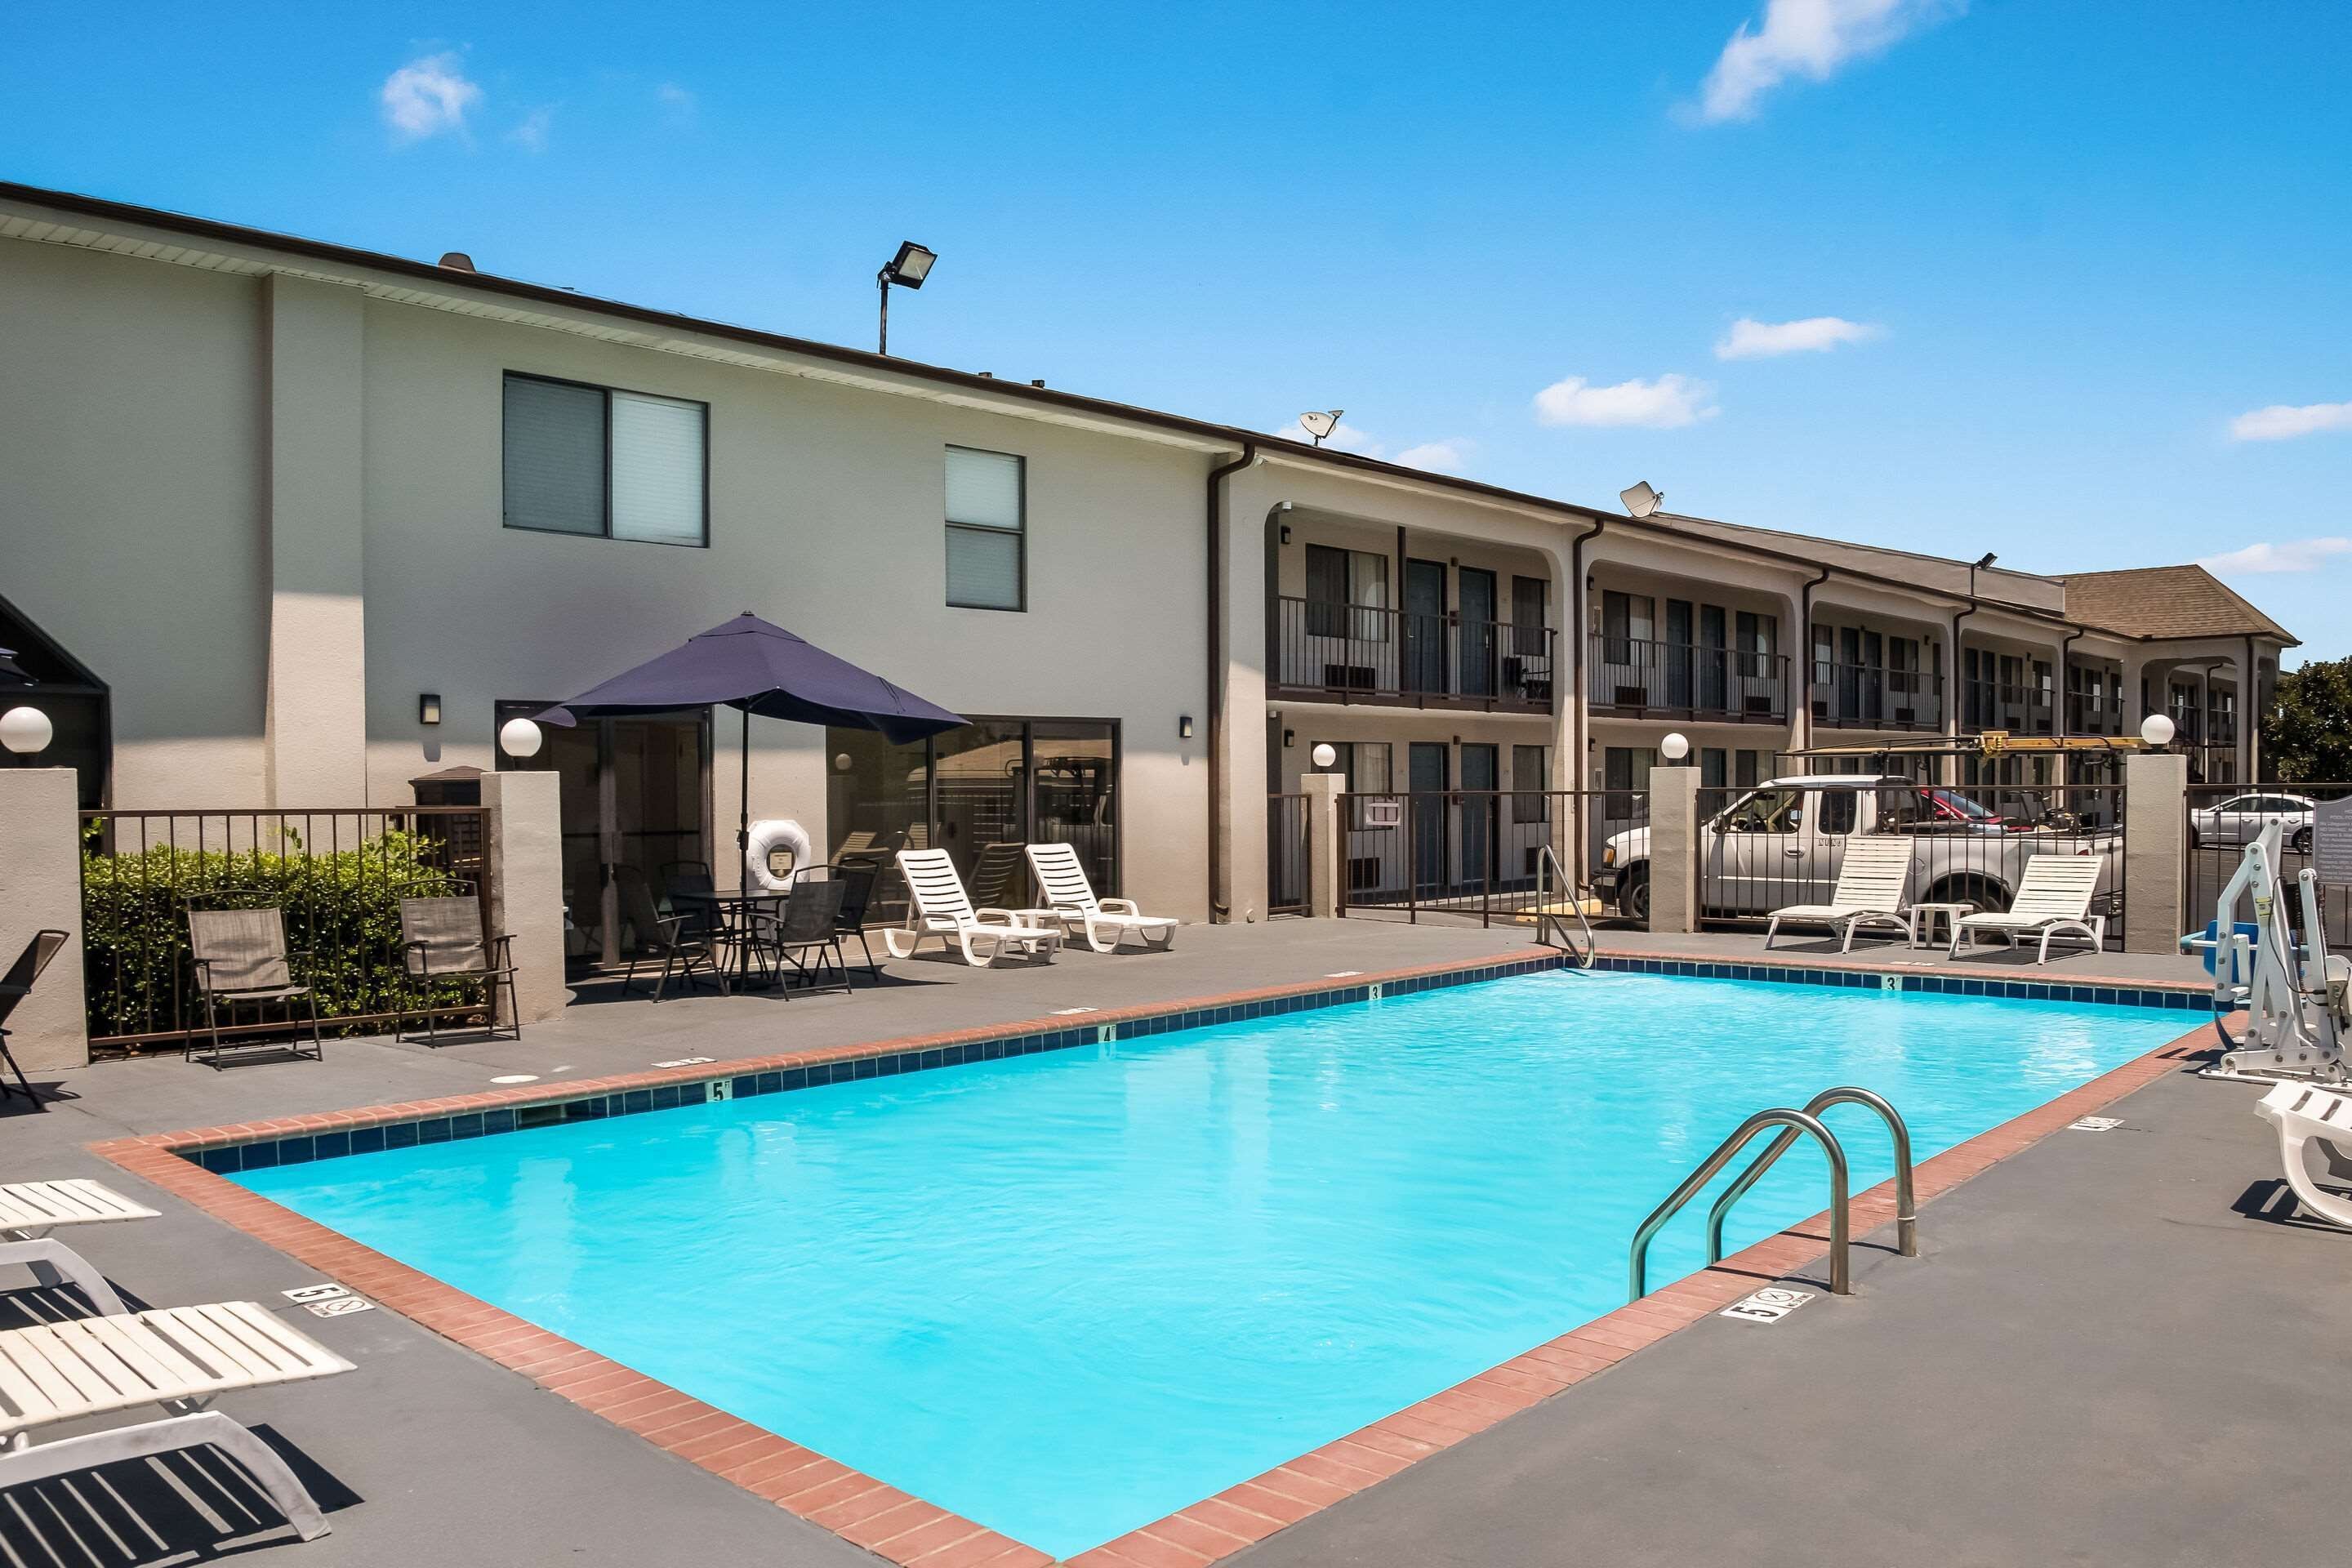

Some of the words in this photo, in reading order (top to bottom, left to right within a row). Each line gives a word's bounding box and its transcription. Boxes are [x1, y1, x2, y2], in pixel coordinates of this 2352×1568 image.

[1886, 977, 1895, 991] 3
[1373, 986, 1378, 1000] 3
[1104, 1026, 1111, 1041] 4
[713, 1082, 724, 1101] 5
[292, 1287, 341, 1298] 5
[1731, 1306, 1780, 1317] 5
